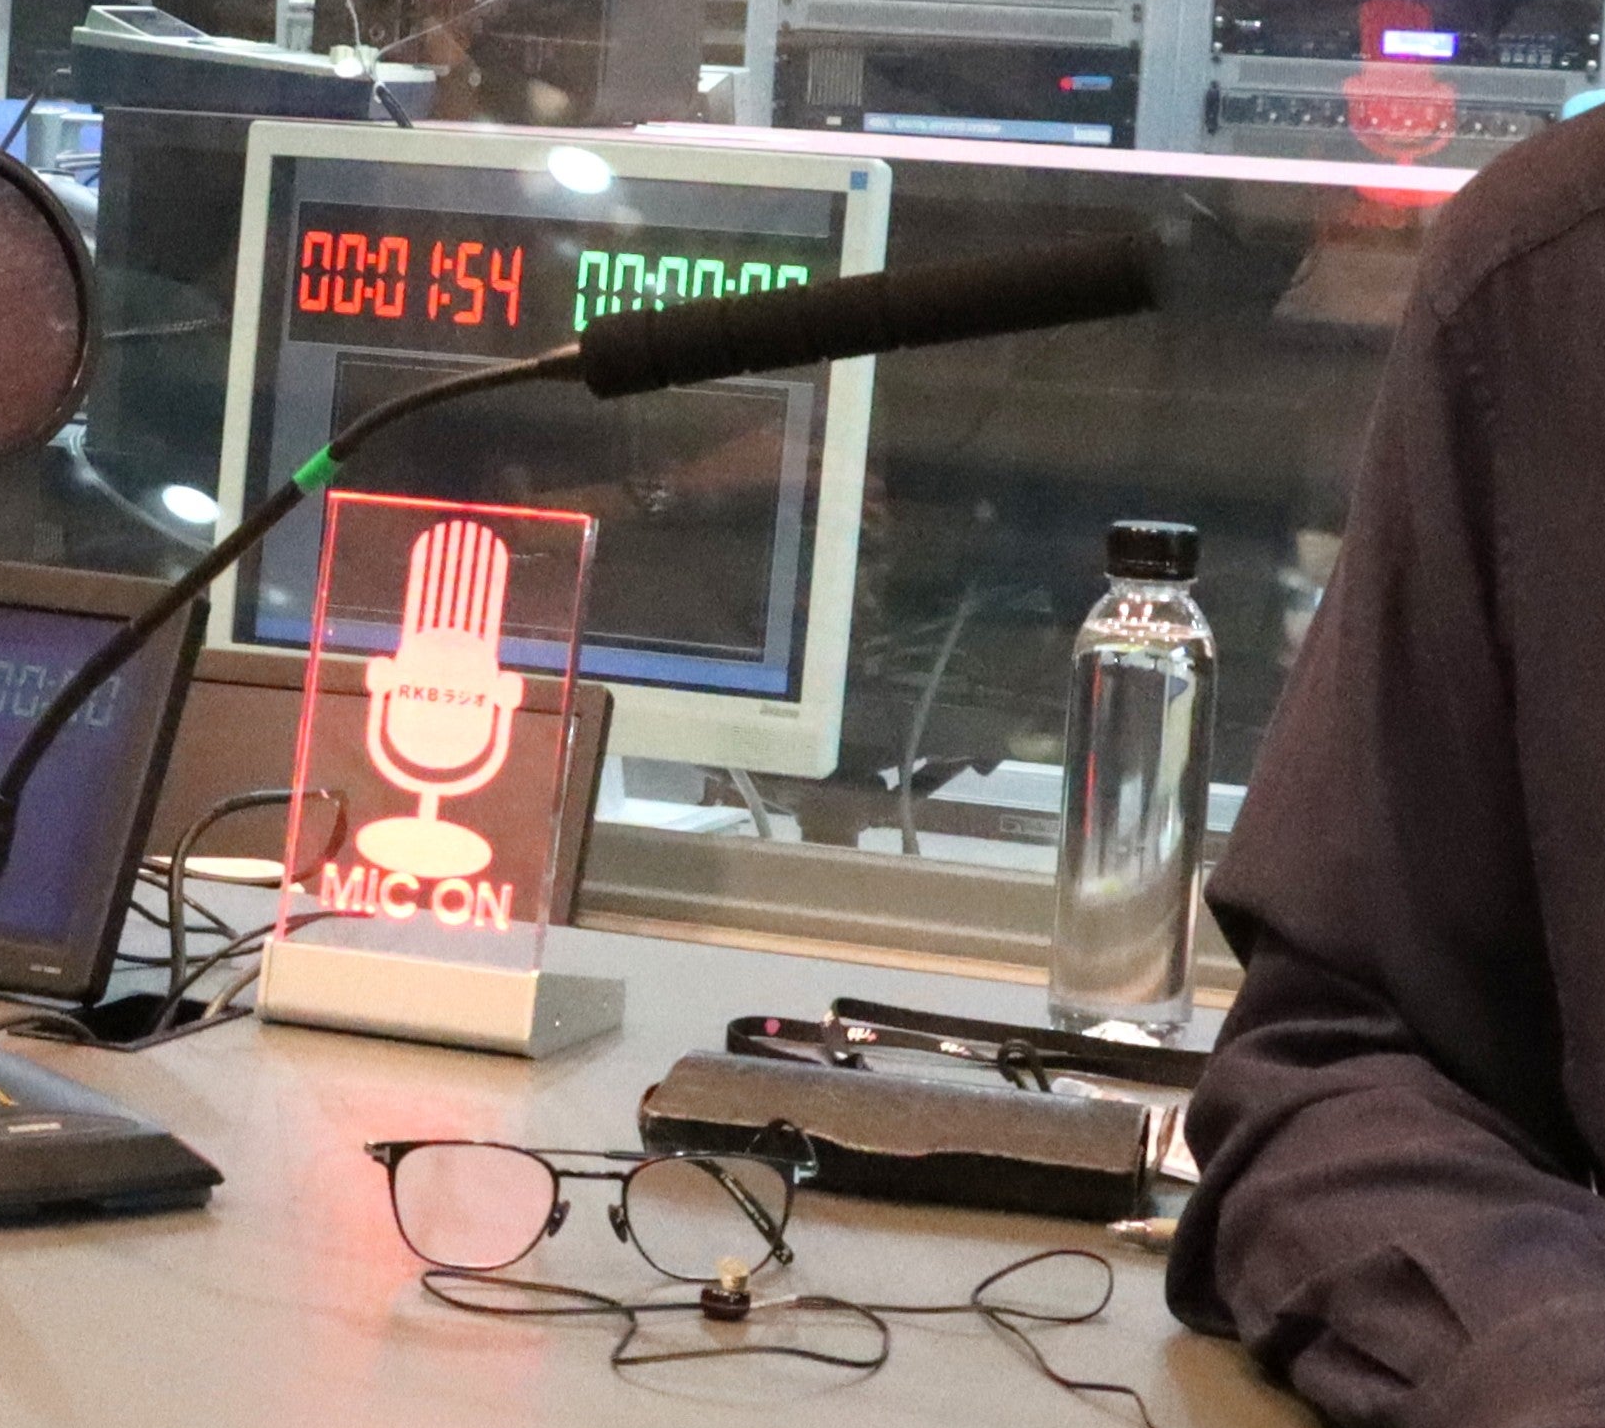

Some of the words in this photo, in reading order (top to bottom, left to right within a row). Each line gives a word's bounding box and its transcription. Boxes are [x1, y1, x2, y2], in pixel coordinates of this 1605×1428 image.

[299, 230, 524, 328] 00:01:54
[319, 862, 420, 919] MIC
[431, 877, 514, 932] ON
